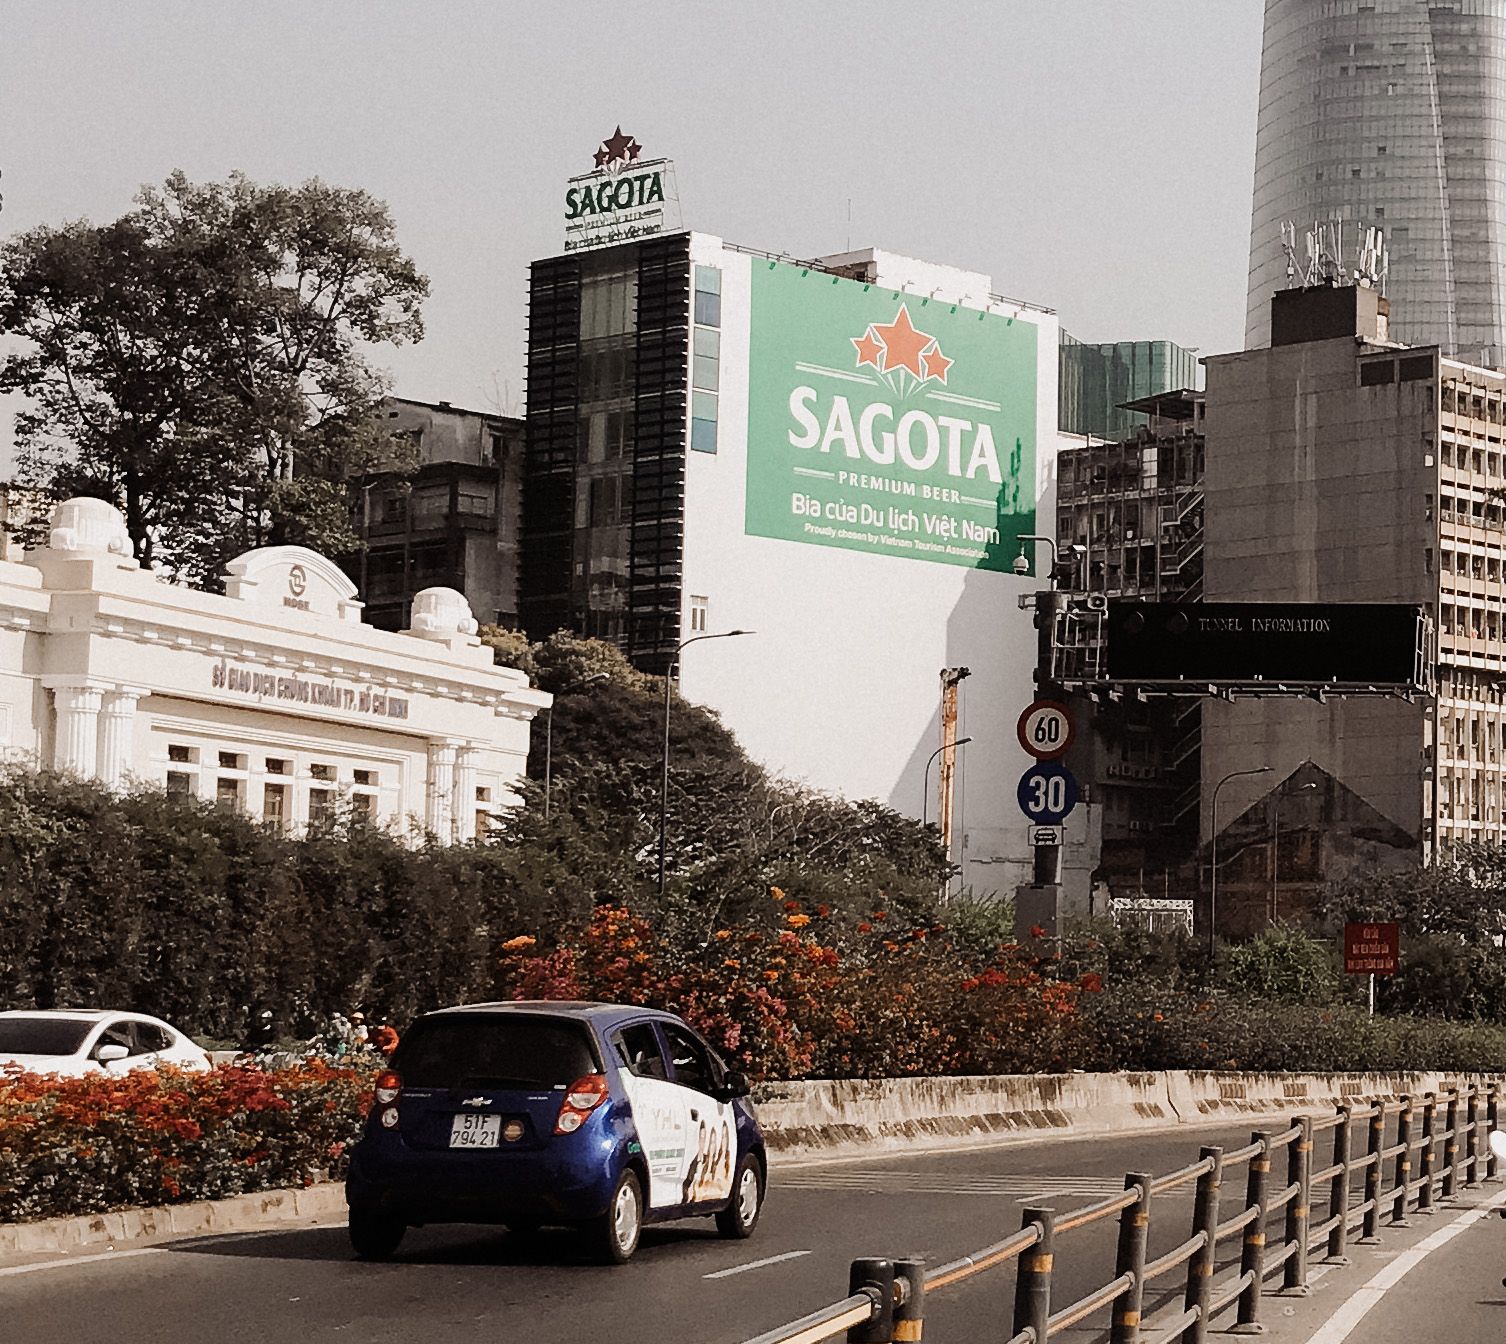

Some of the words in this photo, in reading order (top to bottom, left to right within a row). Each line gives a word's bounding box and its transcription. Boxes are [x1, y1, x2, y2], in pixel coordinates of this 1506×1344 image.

[565, 172, 664, 219] SAGOTA
[788, 386, 1002, 483] SAGOTA
[839, 471, 916, 496] PREMIUM
[922, 485, 960, 503] BEER
[792, 493, 821, 517] Bia
[826, 499, 857, 523] của
[861, 504, 884, 527] Du
[889, 507, 919, 534] lịch
[923, 513, 957, 541] Việt
[962, 519, 1000, 544] Nam
[804, 523, 836, 538] Proudly
[837, 529, 867, 541] chosen
[867, 533, 878, 544] by
[880, 534, 913, 548] Vietnam
[914, 539, 945, 553] Tourism
[1200, 618, 1242, 632] TUNNEL
[1252, 618, 1331, 632] INFORMATION
[228, 667, 251, 693] GIAO
[1034, 716, 1060, 743] 60
[1028, 775, 1066, 813] 30
[464, 1115, 491, 1129] 51F
